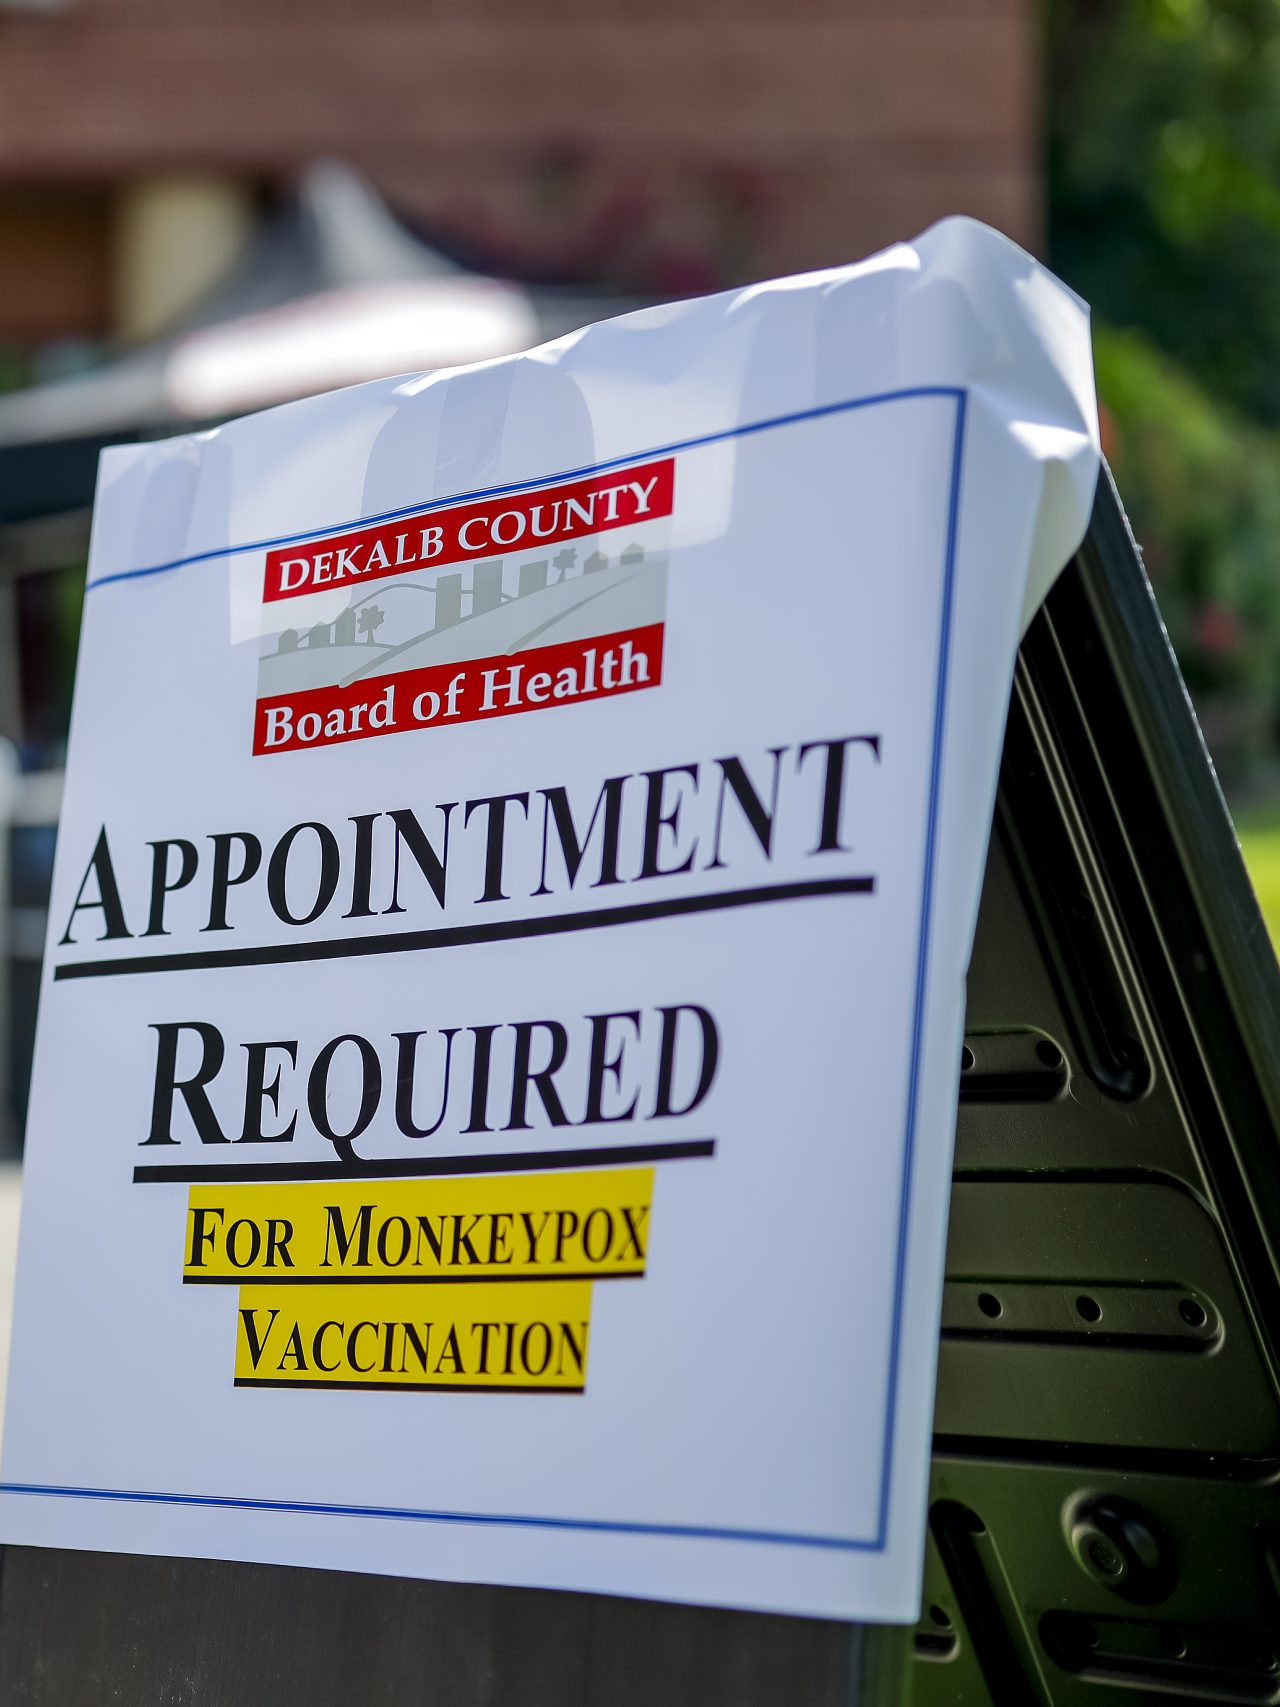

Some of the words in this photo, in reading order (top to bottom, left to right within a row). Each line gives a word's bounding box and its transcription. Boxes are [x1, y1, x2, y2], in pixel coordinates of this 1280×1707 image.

[279, 525, 445, 592] DEKALB
[457, 476, 659, 545] COUNTY
[263, 680, 396, 748] Board
[412, 673, 466, 721] of
[479, 643, 651, 712] Health
[59, 734, 880, 945] APPOINTMENT
[137, 1003, 721, 1162] REQUIRED
[187, 1206, 295, 1268] FOR
[320, 1204, 649, 1267] MONKEYPOX
[239, 1309, 588, 1376] VACCINATION
